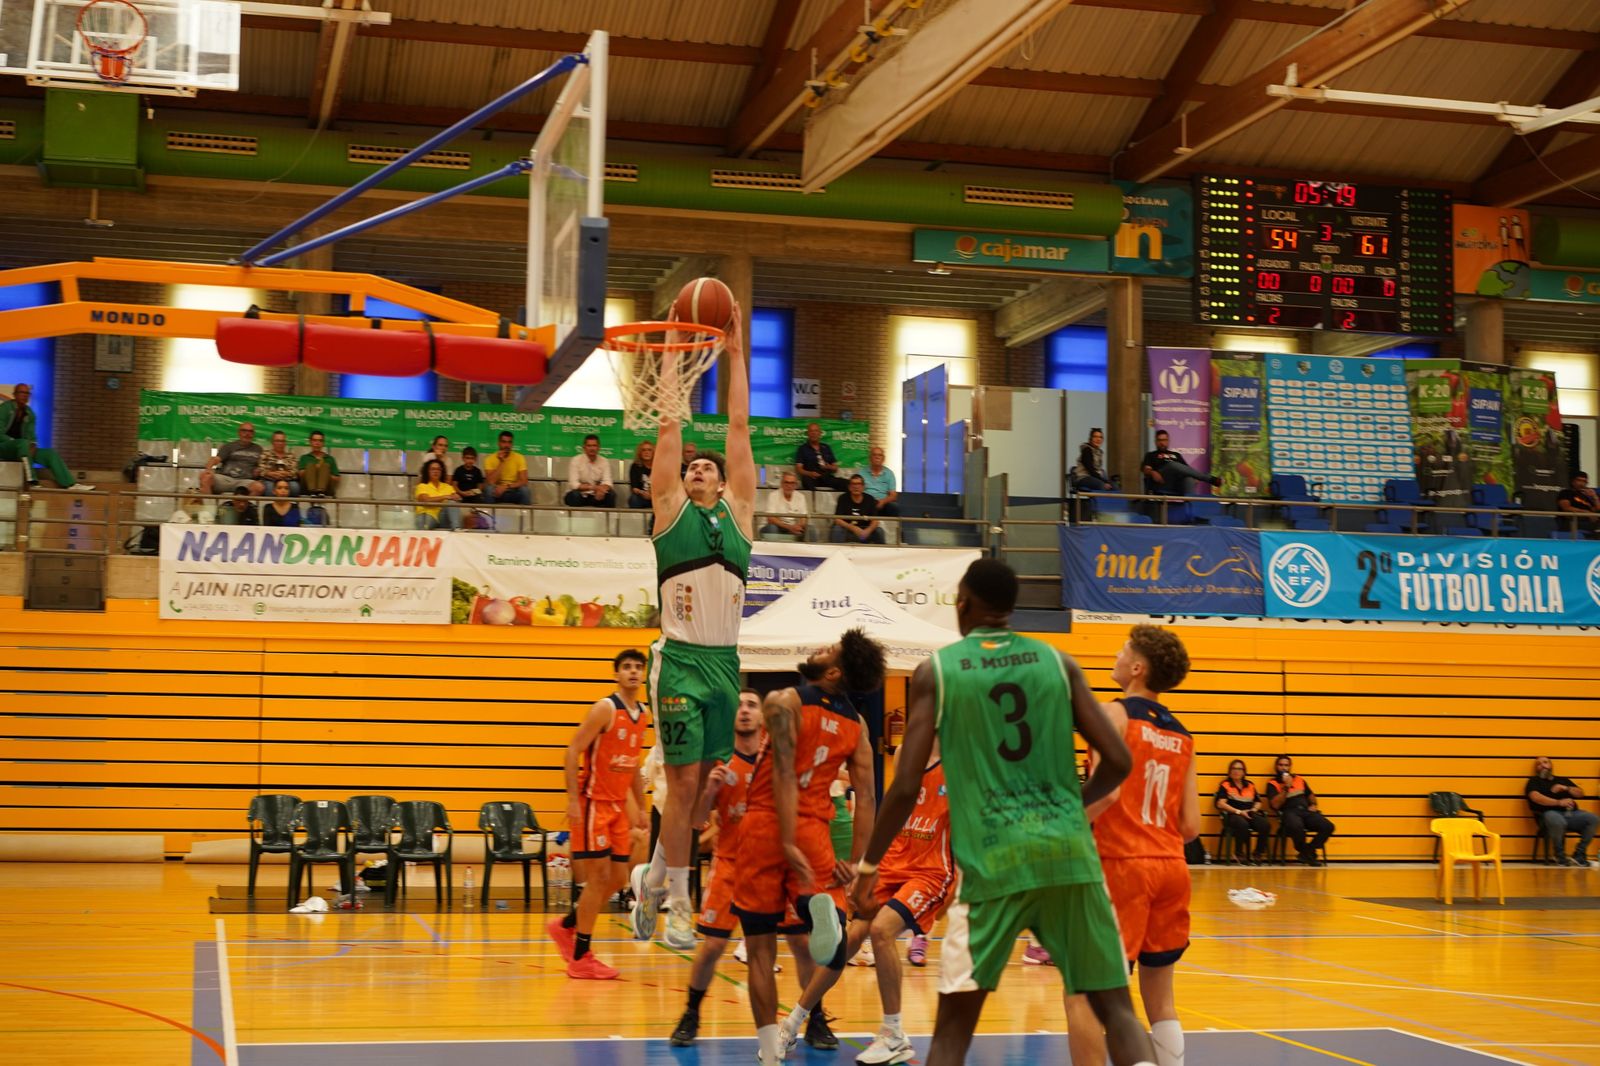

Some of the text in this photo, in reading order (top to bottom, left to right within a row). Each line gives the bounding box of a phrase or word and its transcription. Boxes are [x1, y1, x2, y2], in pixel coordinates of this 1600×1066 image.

[1261, 209, 1299, 222] LOCAL
[1271, 229, 1297, 250] 54
[1321, 224, 1332, 241] 3
[981, 238, 1069, 263] cajamar
[1361, 235, 1388, 255] 61
[1257, 272, 1322, 292] 00 0
[1332, 277, 1395, 297] 00 0
[91, 310, 166, 326] MONDO
[1268, 307, 1280, 324] 2
[1343, 311, 1355, 329] 2
[794, 383, 819, 395] W.C
[1223, 387, 1258, 399] SIPAN
[1418, 384, 1449, 398] K-20
[1521, 385, 1548, 399] K-20
[330, 407, 399, 419] INAGROUP
[404, 409, 472, 421] INAGROUP
[478, 411, 545, 424] INAGROUP
[551, 414, 617, 427] INAGROUP
[178, 530, 442, 567] NAANDANJAIN
[487, 555, 531, 567] Ramiro
[535, 556, 580, 568] Arnedo
[1095, 544, 1163, 581] imd
[1397, 549, 1559, 570] DIVISIÓN
[1288, 564, 1310, 574] RF
[1289, 576, 1311, 586] EF
[1398, 566, 1564, 613] FÚTBOL SALA
[171, 582, 434, 600] A JAIN IRRIGATION COMPANY
[811, 596, 851, 610] imd
[960, 652, 1040, 671] B. MURGI
[988, 682, 1033, 762] 3
[662, 721, 687, 746] 32
[1141, 759, 1170, 828] 11
